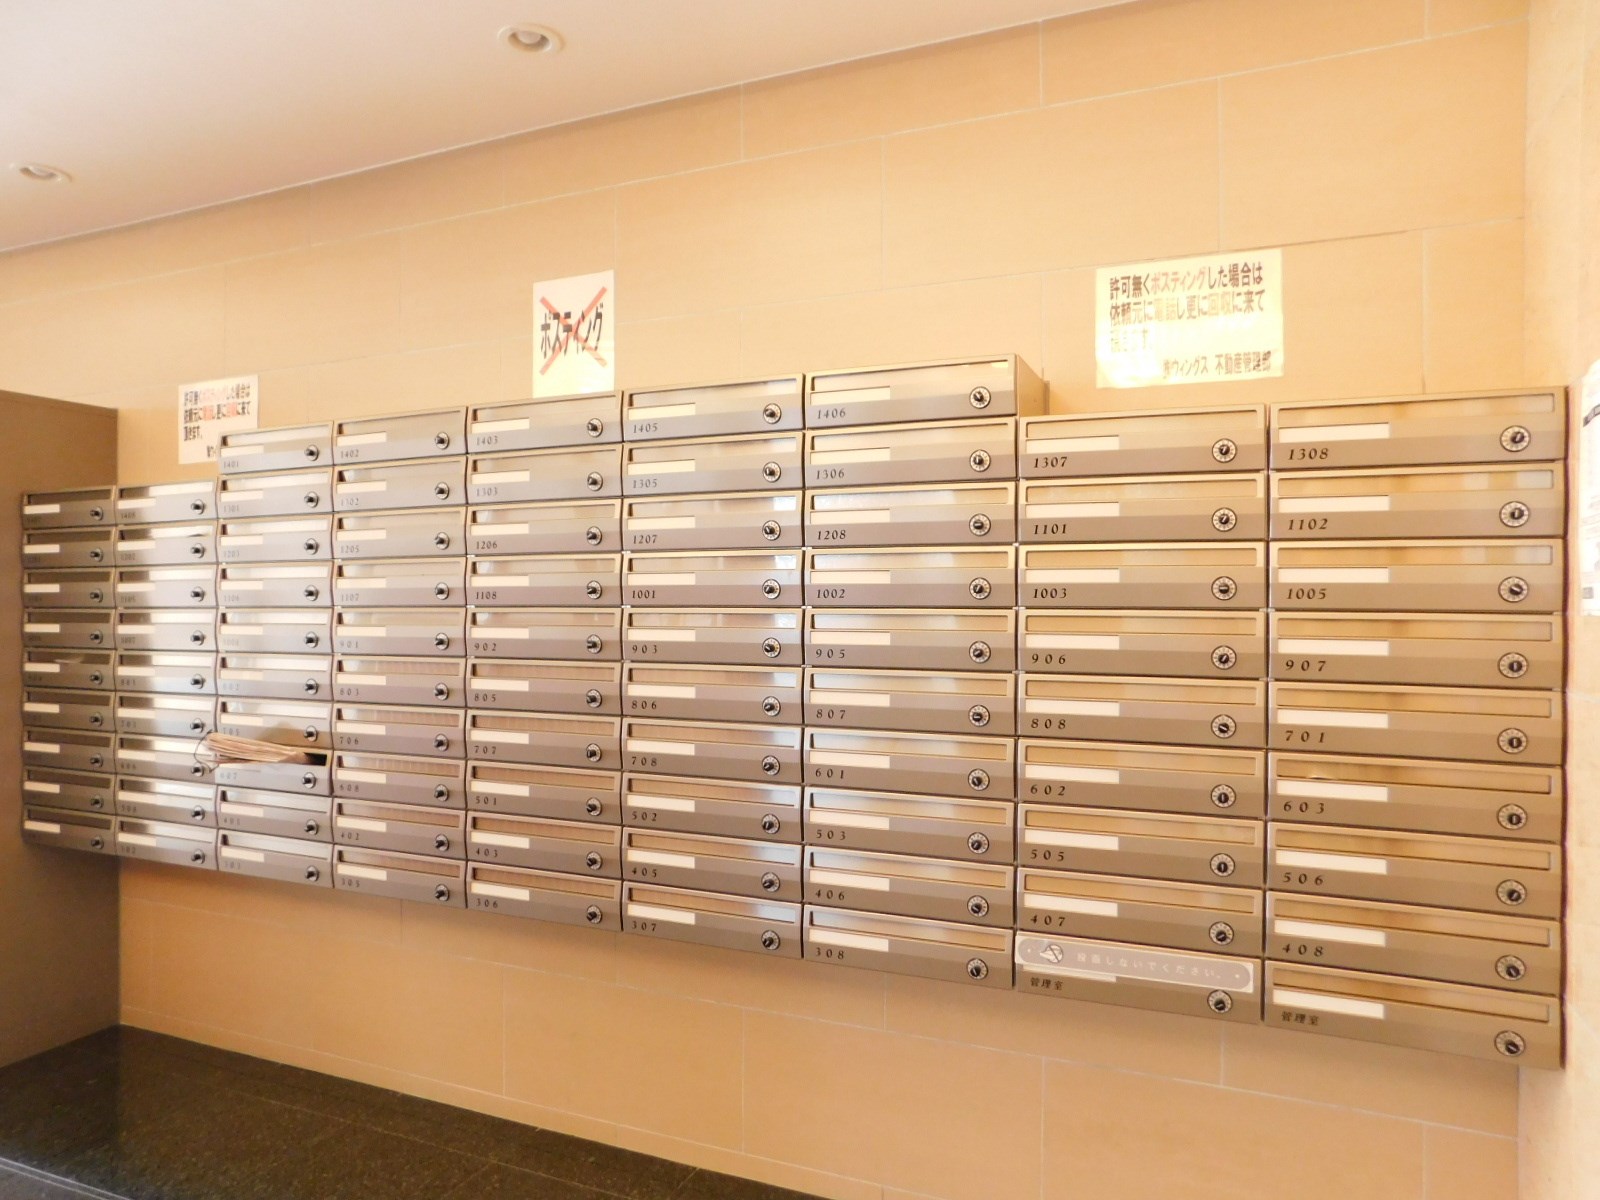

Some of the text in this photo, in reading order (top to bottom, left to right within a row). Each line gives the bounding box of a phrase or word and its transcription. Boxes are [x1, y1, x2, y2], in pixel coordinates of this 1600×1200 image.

[817, 408, 846, 419] 1406
[633, 422, 658, 433] 1405
[1288, 448, 1329, 460] 1308
[1033, 456, 1068, 468] 1307
[816, 469, 845, 480] 1306
[632, 479, 657, 489] 1305
[1033, 523, 1067, 535] 1101
[1287, 518, 1328, 530] 1102
[633, 534, 657, 544] 1207
[817, 529, 846, 541] 1208
[476, 541, 498, 550] 1206
[475, 591, 497, 600] 1108
[632, 590, 656, 599] 1001
[816, 588, 845, 599] 1002
[1032, 588, 1067, 599] 1003
[1286, 588, 1327, 600] 1005
[632, 644, 658, 654] 903
[815, 649, 846, 659] 905
[1031, 653, 1066, 665] 906
[1285, 659, 1326, 672] 907
[631, 700, 657, 710] 806
[816, 709, 846, 720] 807
[1030, 718, 1066, 730] 808
[1285, 730, 1325, 743] 701
[631, 756, 657, 767] 708
[815, 768, 845, 779] 601
[1030, 785, 1065, 796] 602
[1283, 802, 1325, 814] 603
[631, 811, 657, 822] 502
[816, 829, 846, 840] 503
[1030, 849, 1065, 861] 505
[631, 867, 657, 878] 405
[1282, 872, 1324, 886] 506
[815, 889, 845, 901] 406
[631, 920, 657, 932] 307
[1030, 915, 1066, 927] 407
[815, 947, 845, 960] 308
[1281, 944, 1324, 957] 408
[1030, 977, 1063, 991] 管理室
[1280, 1011, 1319, 1026] 管理室
